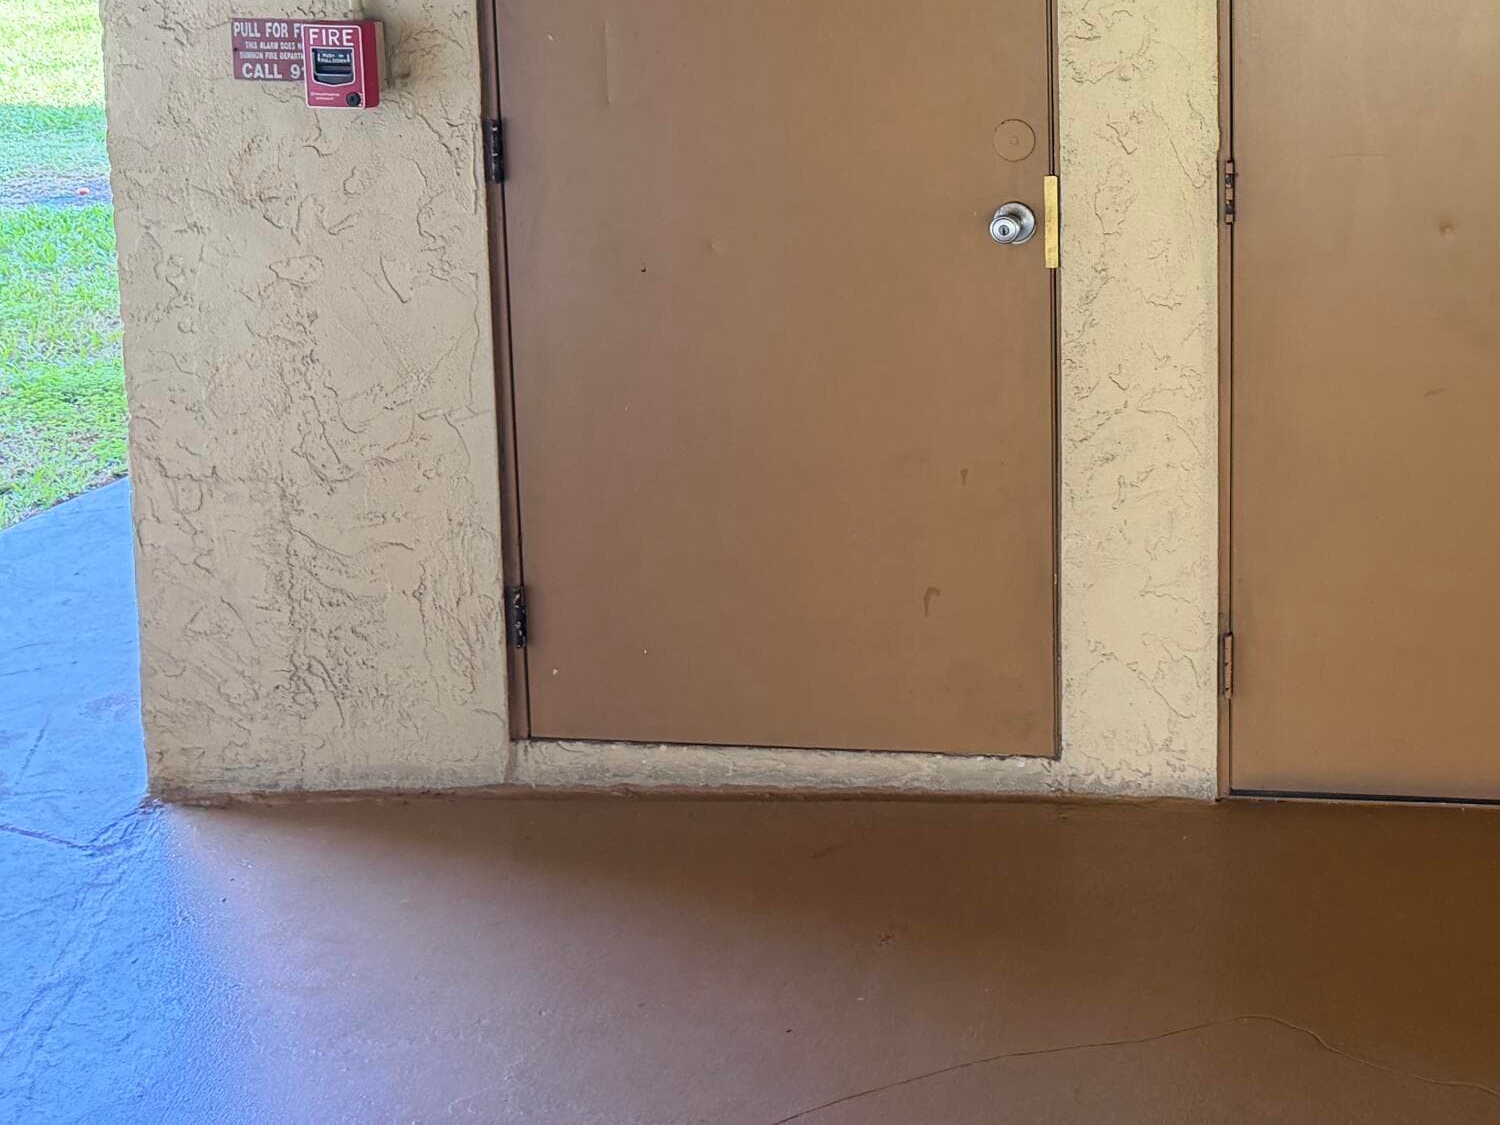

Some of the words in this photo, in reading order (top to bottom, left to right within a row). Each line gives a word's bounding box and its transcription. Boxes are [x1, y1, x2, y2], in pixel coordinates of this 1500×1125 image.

[233, 22, 261, 38] PULL
[265, 22, 289, 38] FOR
[309, 28, 354, 46] FIRE
[245, 41, 257, 49] THIS
[259, 41, 279, 50] ALARM
[280, 42, 296, 50] DOES
[265, 51, 278, 60] FIRE
[242, 62, 283, 79] CALL
